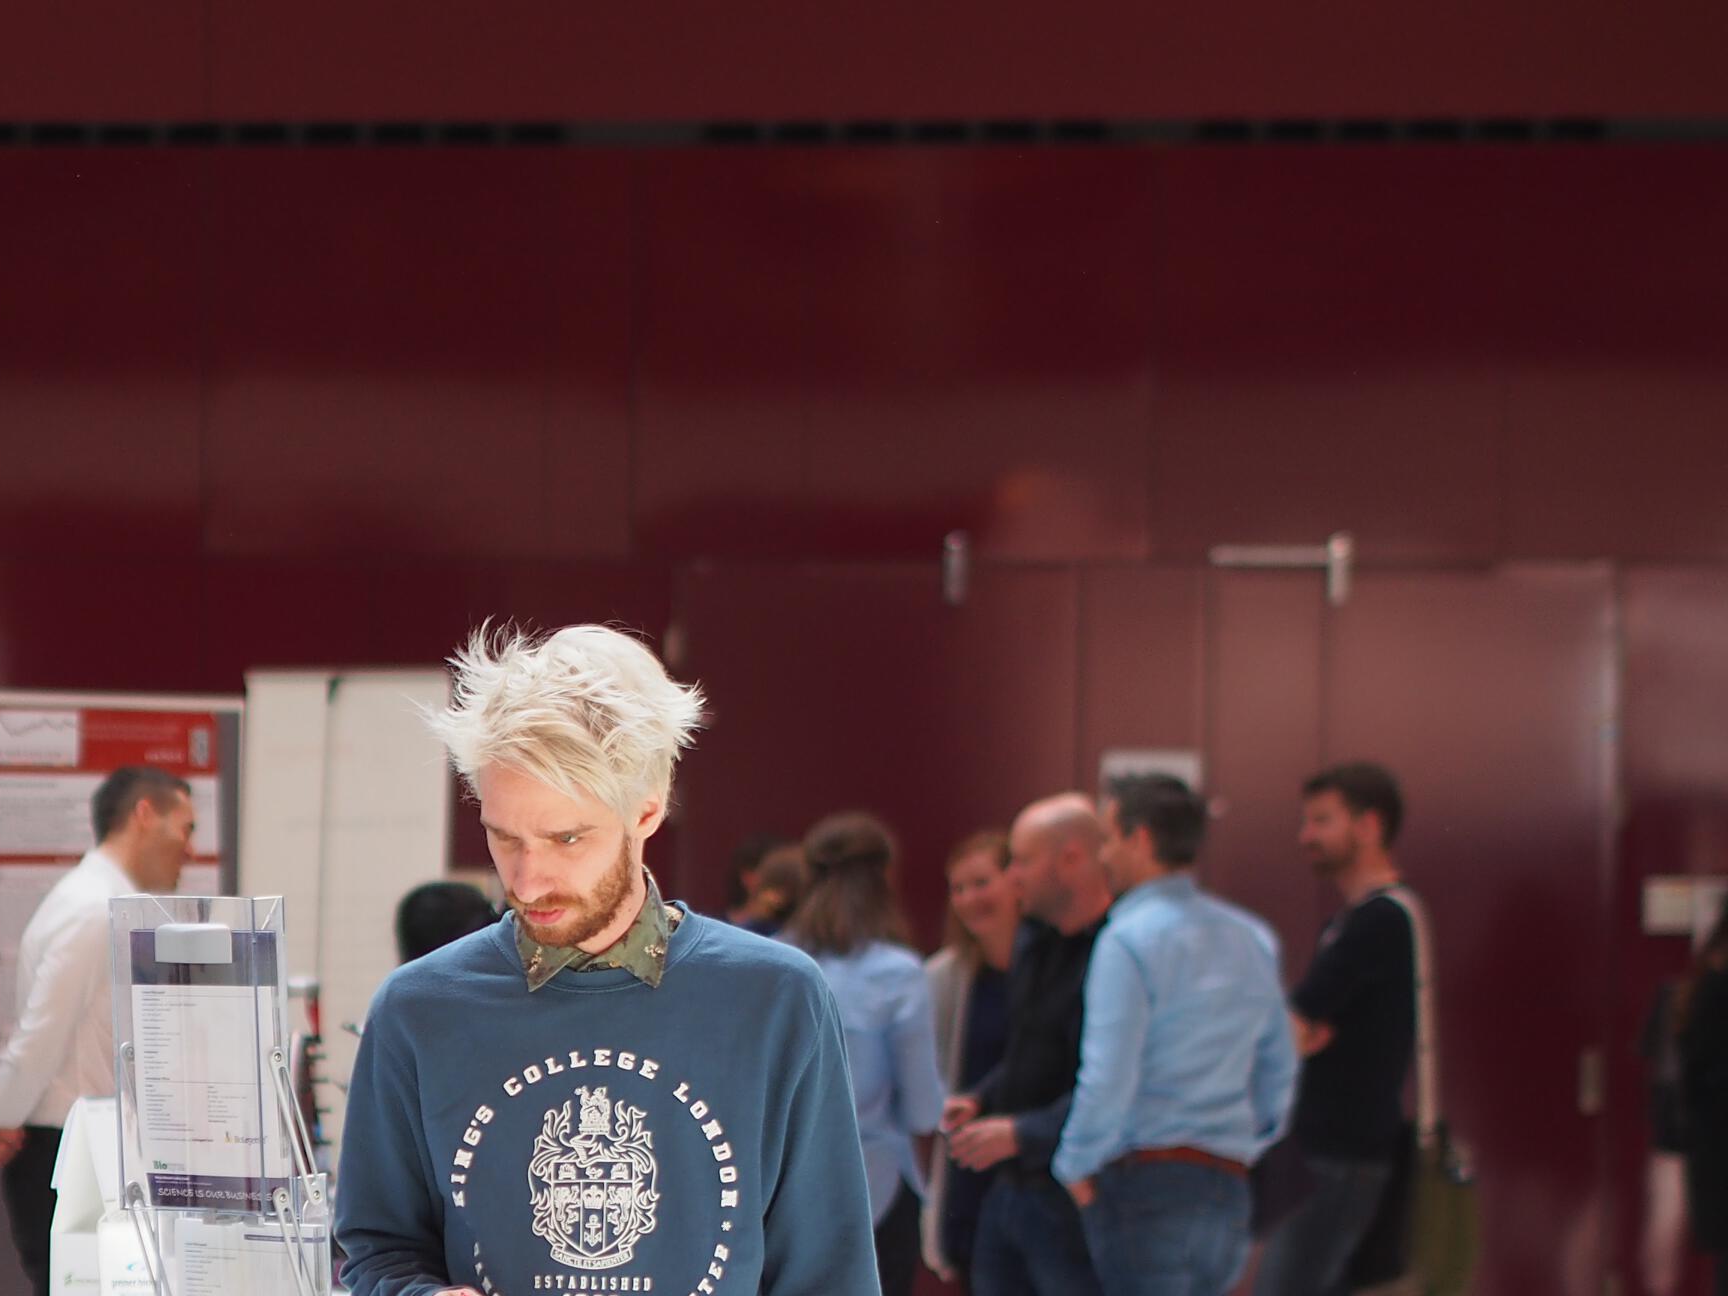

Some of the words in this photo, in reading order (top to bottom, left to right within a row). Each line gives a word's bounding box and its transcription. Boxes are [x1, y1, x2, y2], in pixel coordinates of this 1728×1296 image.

[450, 1104, 495, 1208] KING'S
[502, 1048, 660, 1098] COLLEGE
[672, 1081, 739, 1208] LONDON
[157, 1187, 193, 1198] SCIENCE
[533, 1274, 653, 1292] ESTABLISHED
